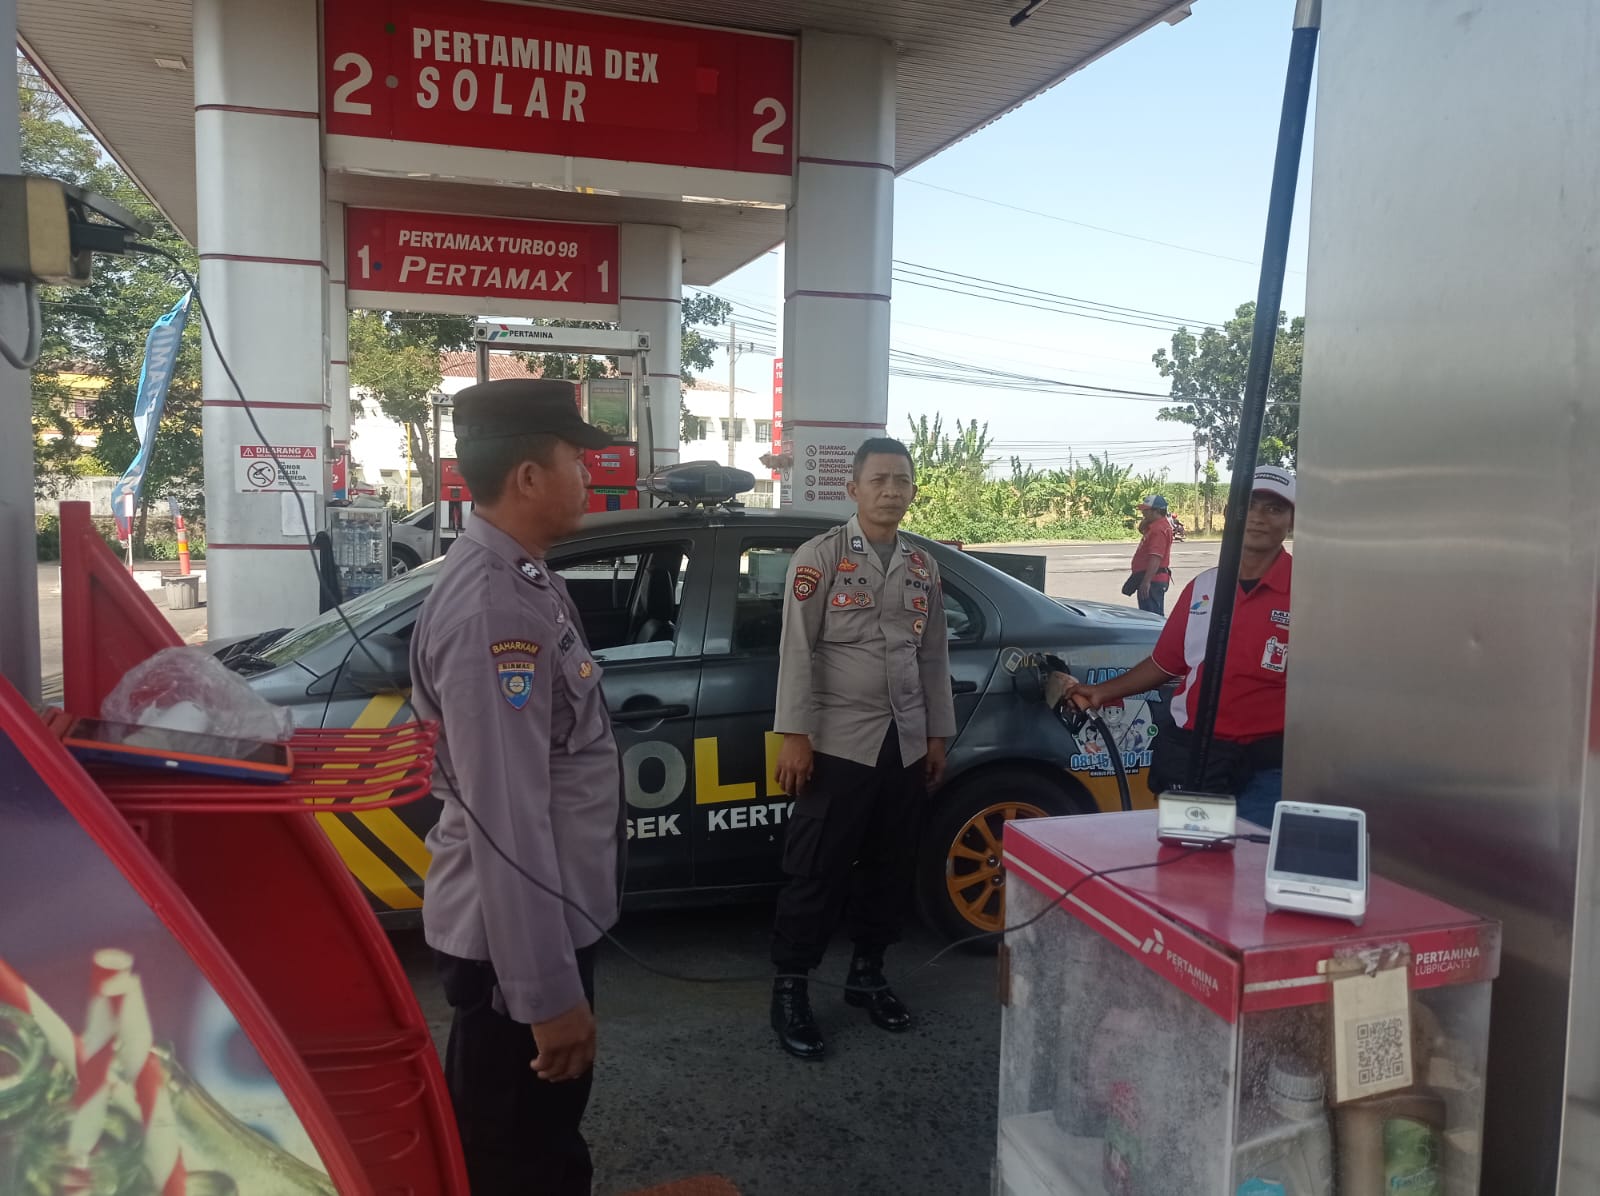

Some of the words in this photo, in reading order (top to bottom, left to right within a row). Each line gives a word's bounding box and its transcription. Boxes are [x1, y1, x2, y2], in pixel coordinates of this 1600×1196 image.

[413, 28, 592, 76] PERTAMINA
[605, 48, 659, 83] DEX
[333, 52, 373, 116] 2
[417, 66, 586, 123] SOLAR
[751, 97, 787, 155] 2
[398, 230, 495, 252] PERTAMAX
[498, 237, 556, 257] TURBO
[558, 241, 578, 258] 98
[357, 245, 370, 279] 1
[399, 255, 573, 292] PERTAMAX
[597, 260, 609, 293] 1
[509, 330, 553, 339] PERTAMINA
[492, 641, 539, 654] BAHARKAM
[1167, 949, 1219, 992] PERTAMINA
[1416, 946, 1480, 965] PERTAMINA
